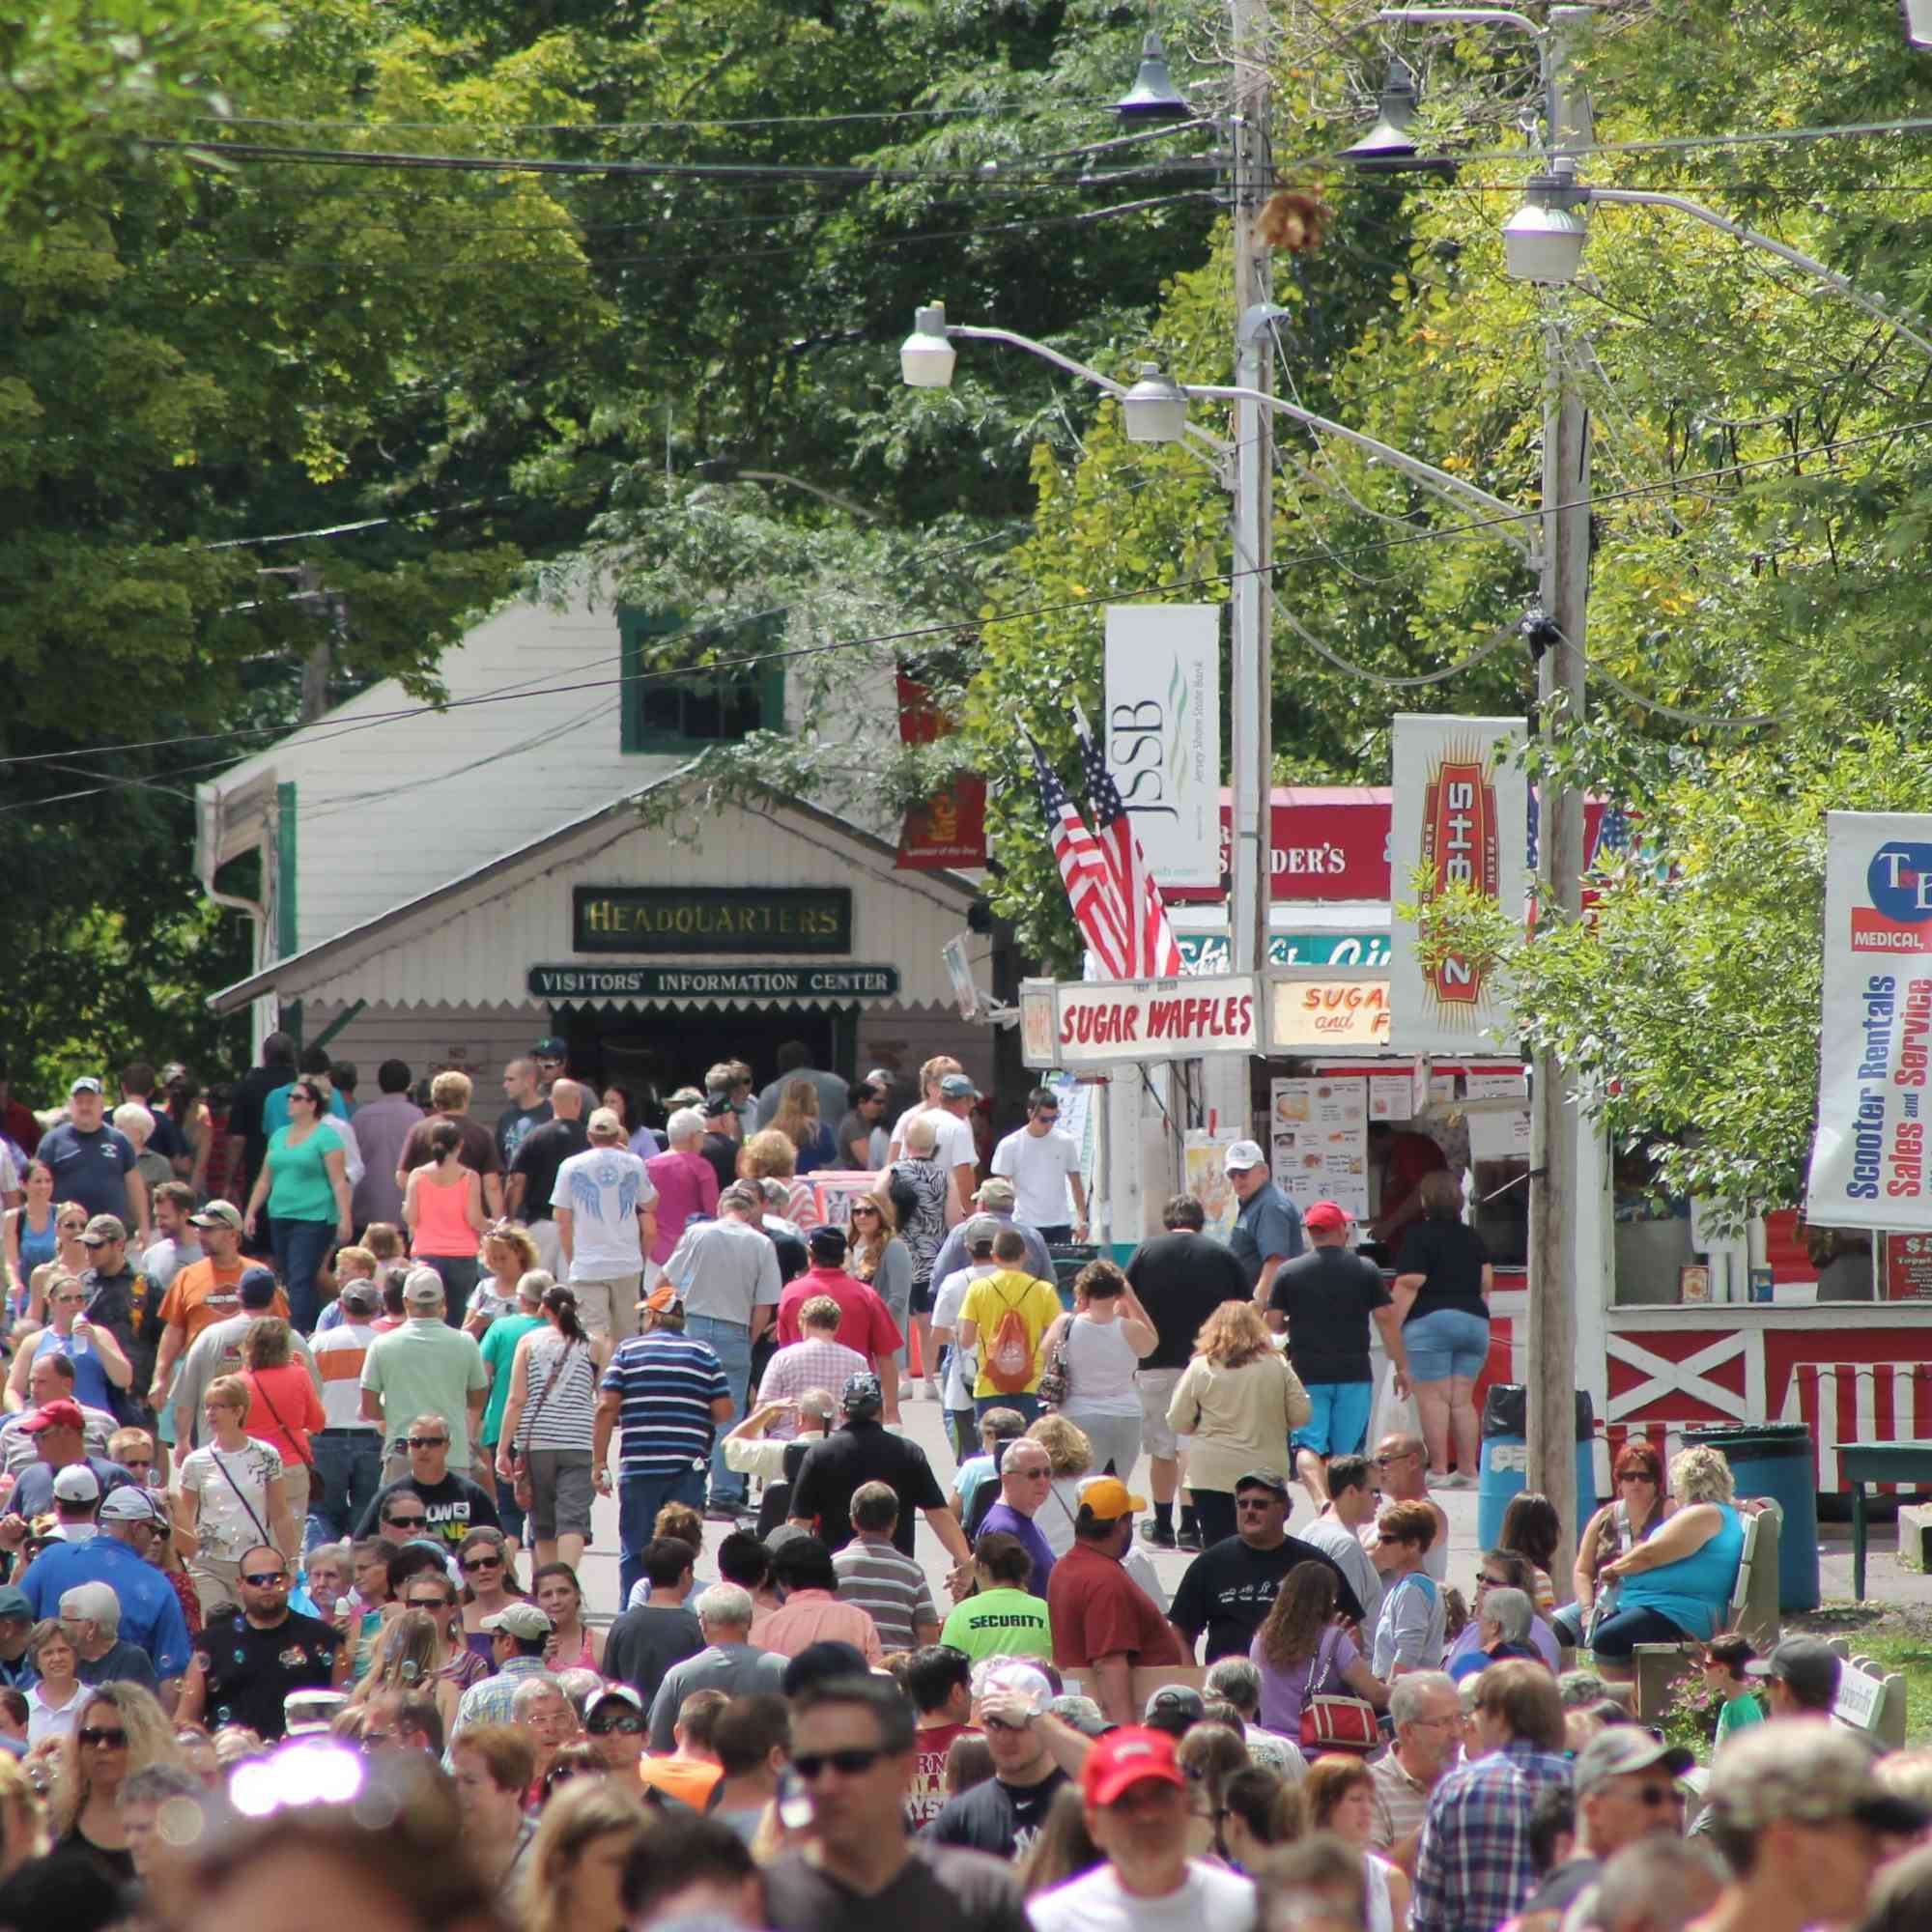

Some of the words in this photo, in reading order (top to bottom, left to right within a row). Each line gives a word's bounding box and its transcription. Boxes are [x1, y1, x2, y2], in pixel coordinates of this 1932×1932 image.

[1112, 700, 1179, 823] JSSB
[1443, 782, 1474, 984] SHEZ
[587, 900, 838, 934] HEADQUARTERS
[541, 972, 644, 991] VISITORS'
[659, 973, 798, 991] INFORMATION
[810, 973, 889, 990] CENTER
[1059, 1004, 1141, 1044] SUGAR
[1147, 995, 1253, 1039] WAFFLES
[1315, 1011, 1354, 1031] and
[1858, 976, 1896, 1080] Rentals
[1894, 979, 1932, 1087] Service
[1903, 1094, 1919, 1118] and
[1846, 1088, 1885, 1199] Scooter
[1887, 1122, 1923, 1197] Sales
[969, 1614, 1044, 1630] SECURITY
